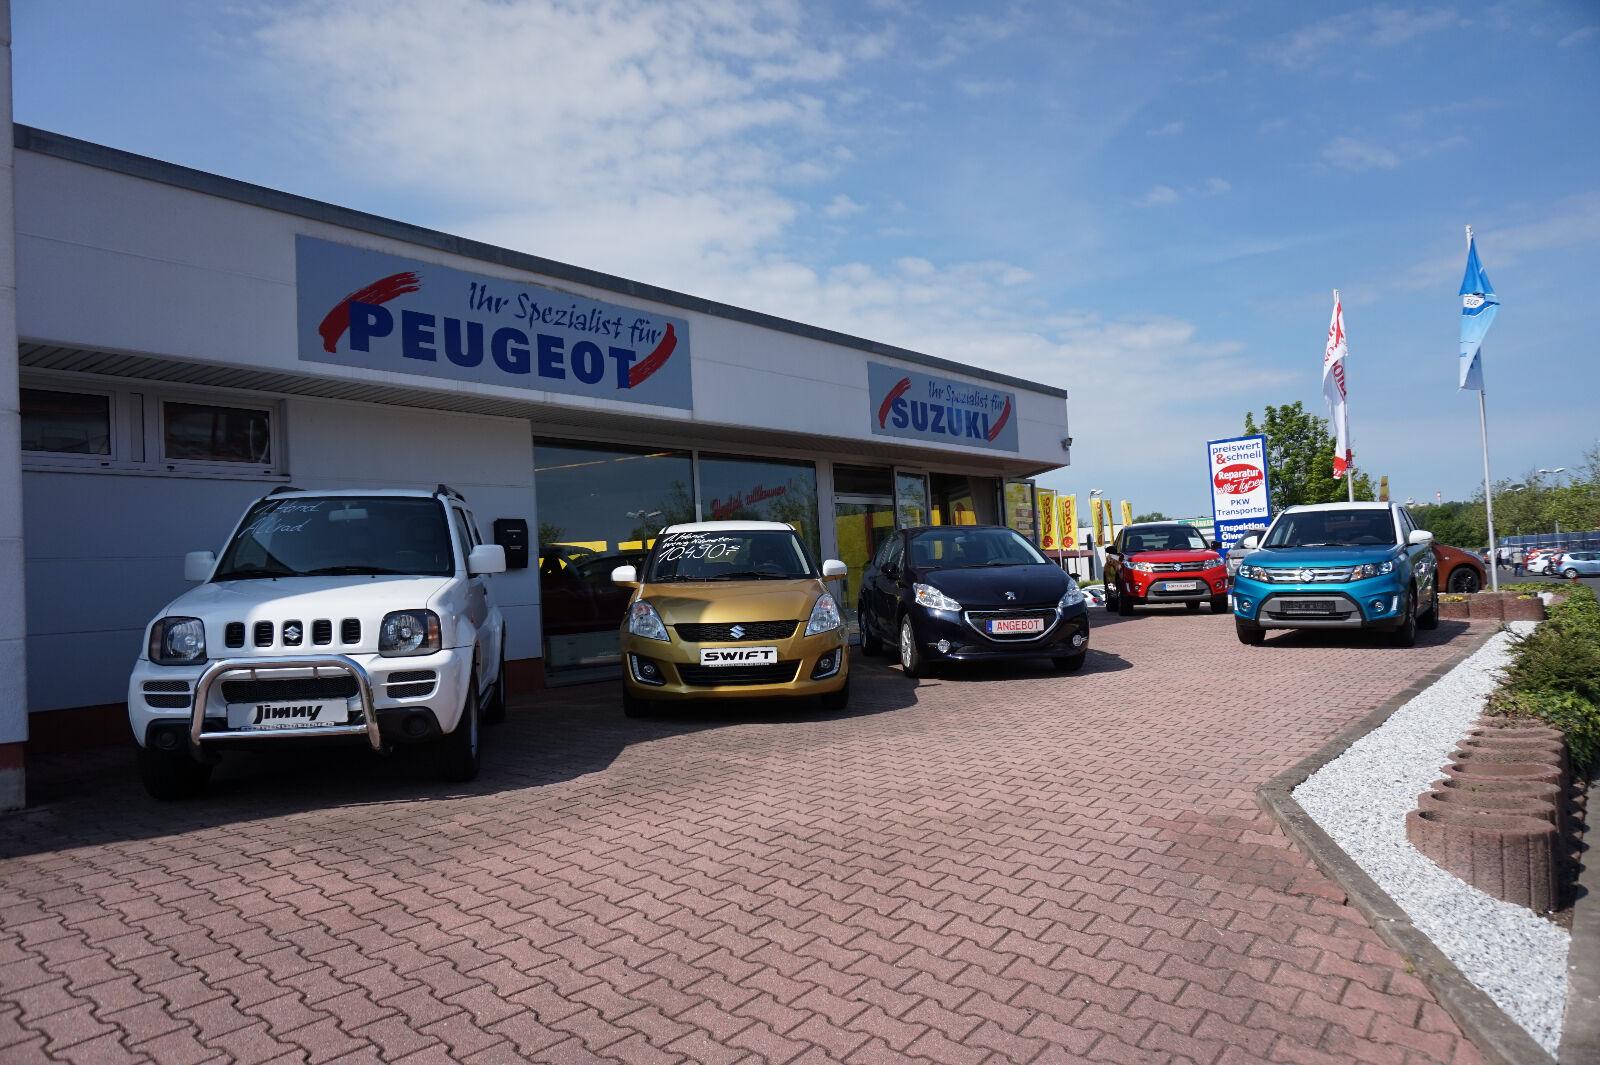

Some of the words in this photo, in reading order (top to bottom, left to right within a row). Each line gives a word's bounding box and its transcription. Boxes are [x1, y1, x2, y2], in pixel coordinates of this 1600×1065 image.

[469, 281, 509, 315] Ihr
[514, 292, 624, 338] Spezialist
[627, 317, 662, 346] für
[349, 301, 637, 390] PEUGEOT
[928, 380, 944, 399] Ihr
[945, 384, 989, 409] Spezialist
[990, 393, 1005, 413] für
[891, 397, 990, 441] SUZUKI
[1212, 441, 1261, 456] preiswert
[1218, 468, 1260, 481] Reparatur
[1230, 498, 1250, 506] PKW
[1216, 506, 1266, 517] Transporter
[1219, 522, 1266, 533] Inspektion
[1221, 532, 1244, 541] Ölwe
[996, 620, 1040, 631] ANGEBOT
[704, 650, 774, 662] SWIFT
[253, 704, 323, 725] Jimny
